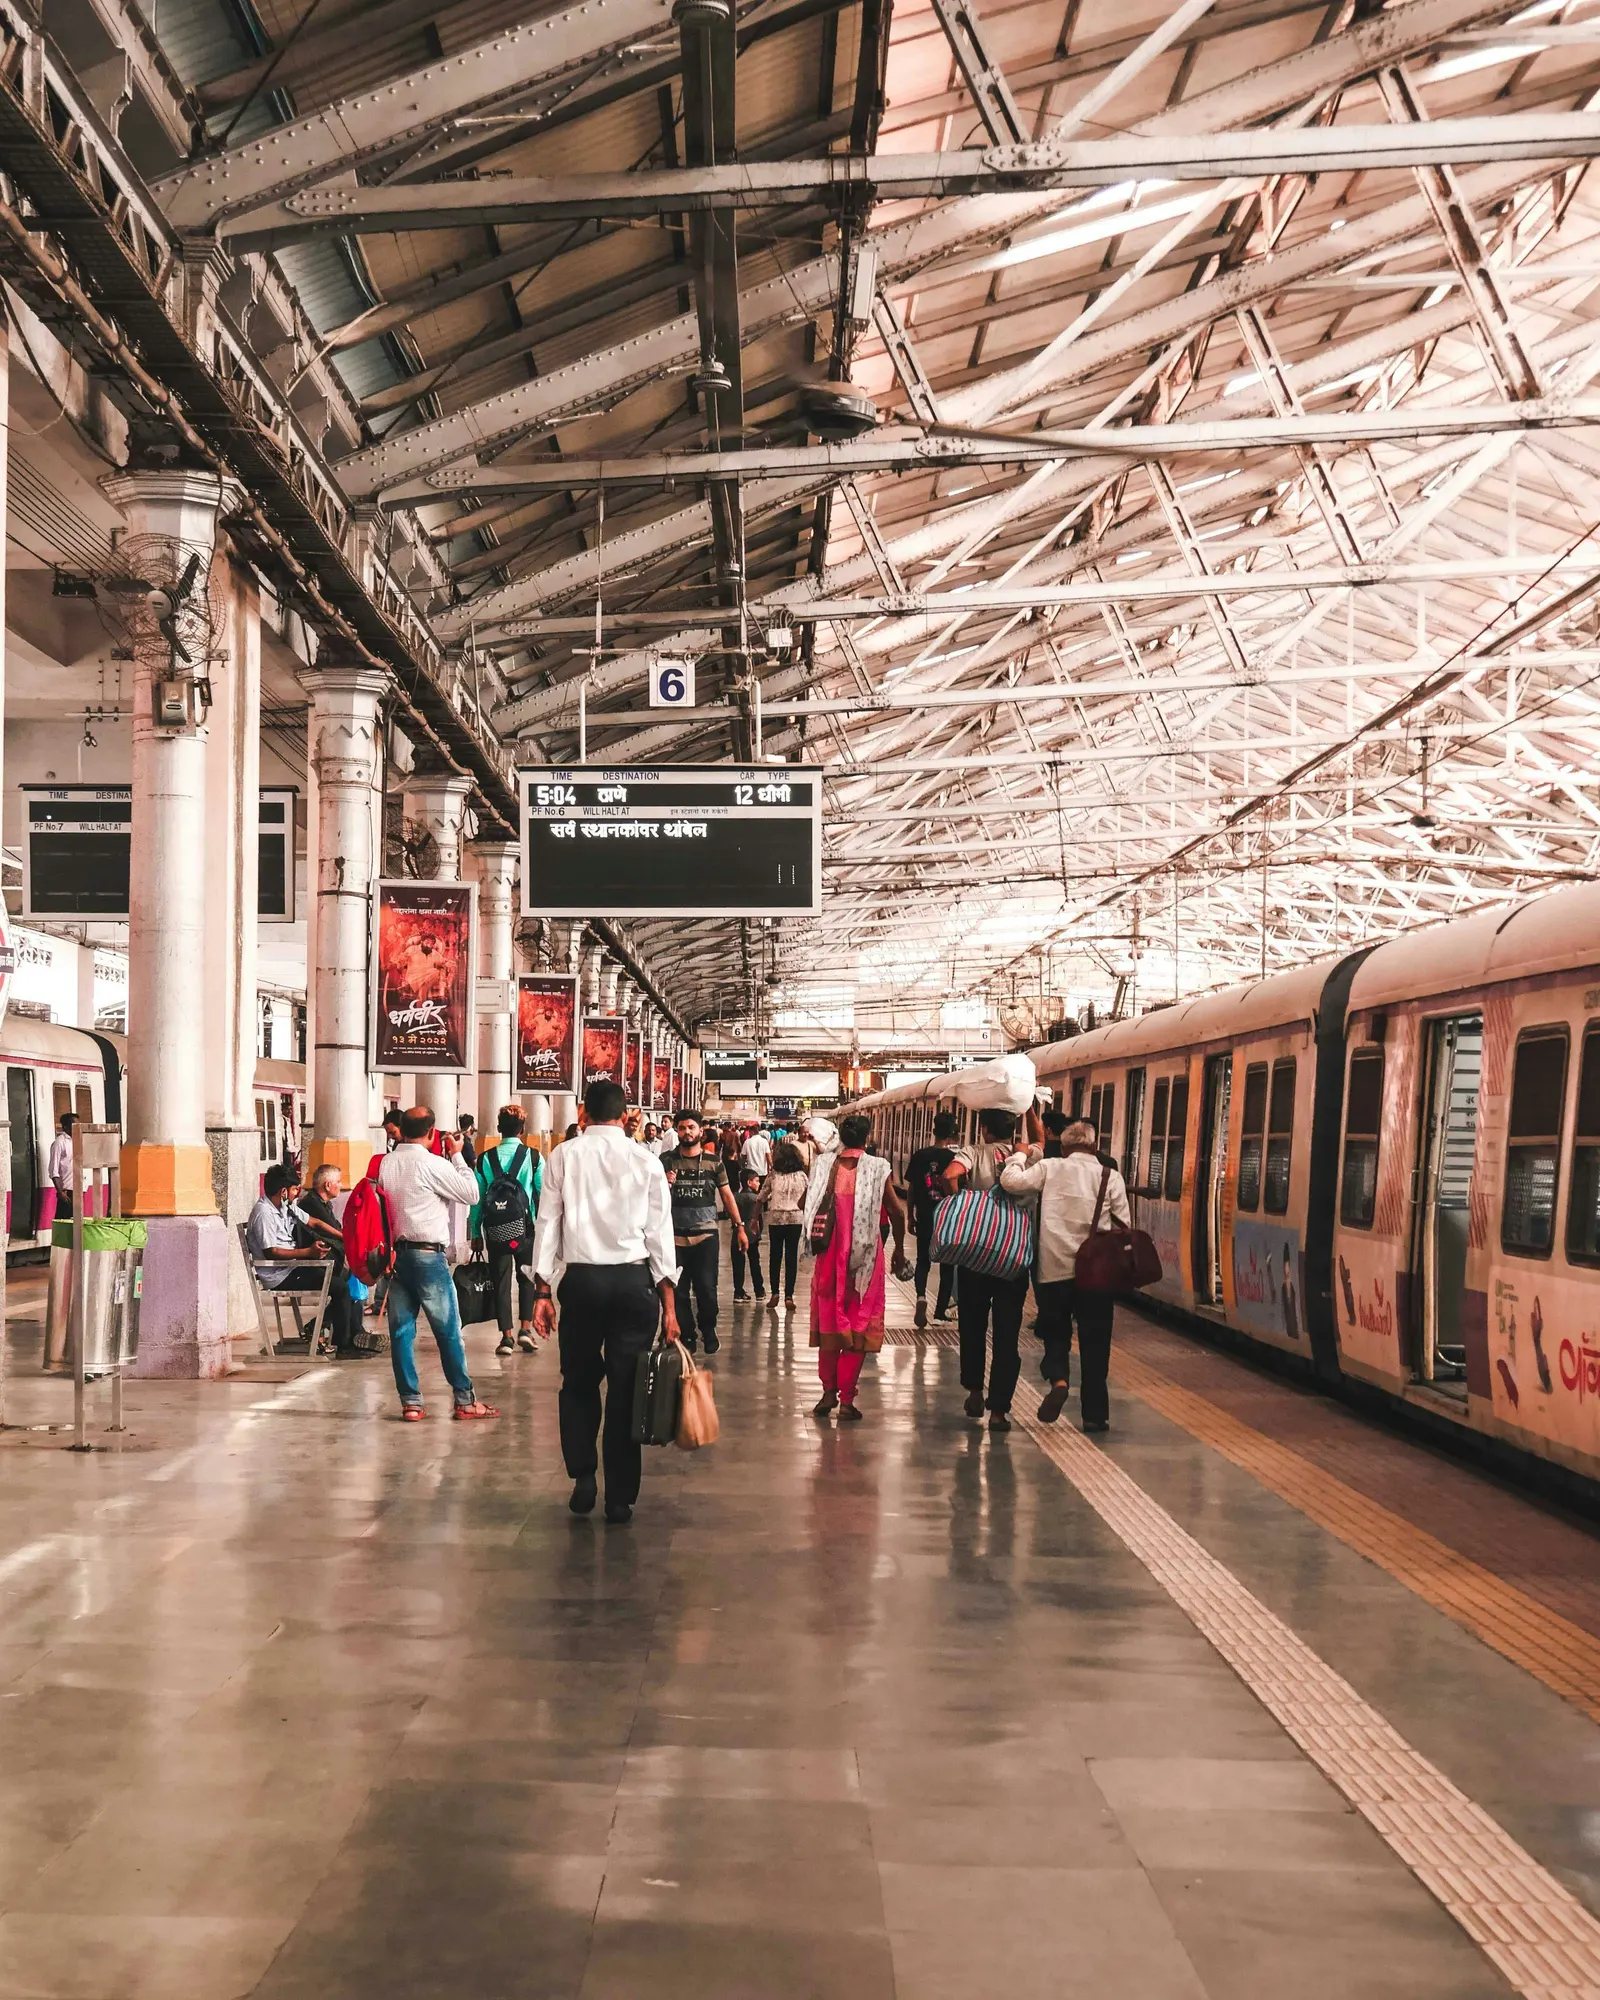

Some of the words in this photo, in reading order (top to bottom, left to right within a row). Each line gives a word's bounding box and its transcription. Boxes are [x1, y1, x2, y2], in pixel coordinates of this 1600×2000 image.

[659, 668, 685, 701] 6
[551, 772, 572, 780] TIME
[602, 772, 660, 780] DESTINATION
[740, 772, 755, 780] CAR
[767, 772, 790, 780] TYPE
[49, 791, 68, 799] TIME
[95, 791, 132, 799] DESTINAT
[537, 785, 577, 805] 5:04
[597, 784, 627, 803] ठाणे
[734, 785, 754, 805] 12
[532, 807, 542, 815] PF
[582, 807, 600, 815] WILL
[601, 807, 620, 815] HALT
[621, 807, 630, 815] AT
[34, 822, 43, 830] PF
[79, 823, 94, 831] WILL
[96, 823, 113, 831] HALT
[113, 823, 122, 831] AT
[549, 819, 577, 838] सर्व
[579, 819, 660, 838] स्थानकांवर
[663, 819, 708, 838] थांबेल
[389, 1000, 448, 1028] धर्मवीर
[734, 1028, 741, 1036] 6
[982, 1031, 988, 1039] 6
